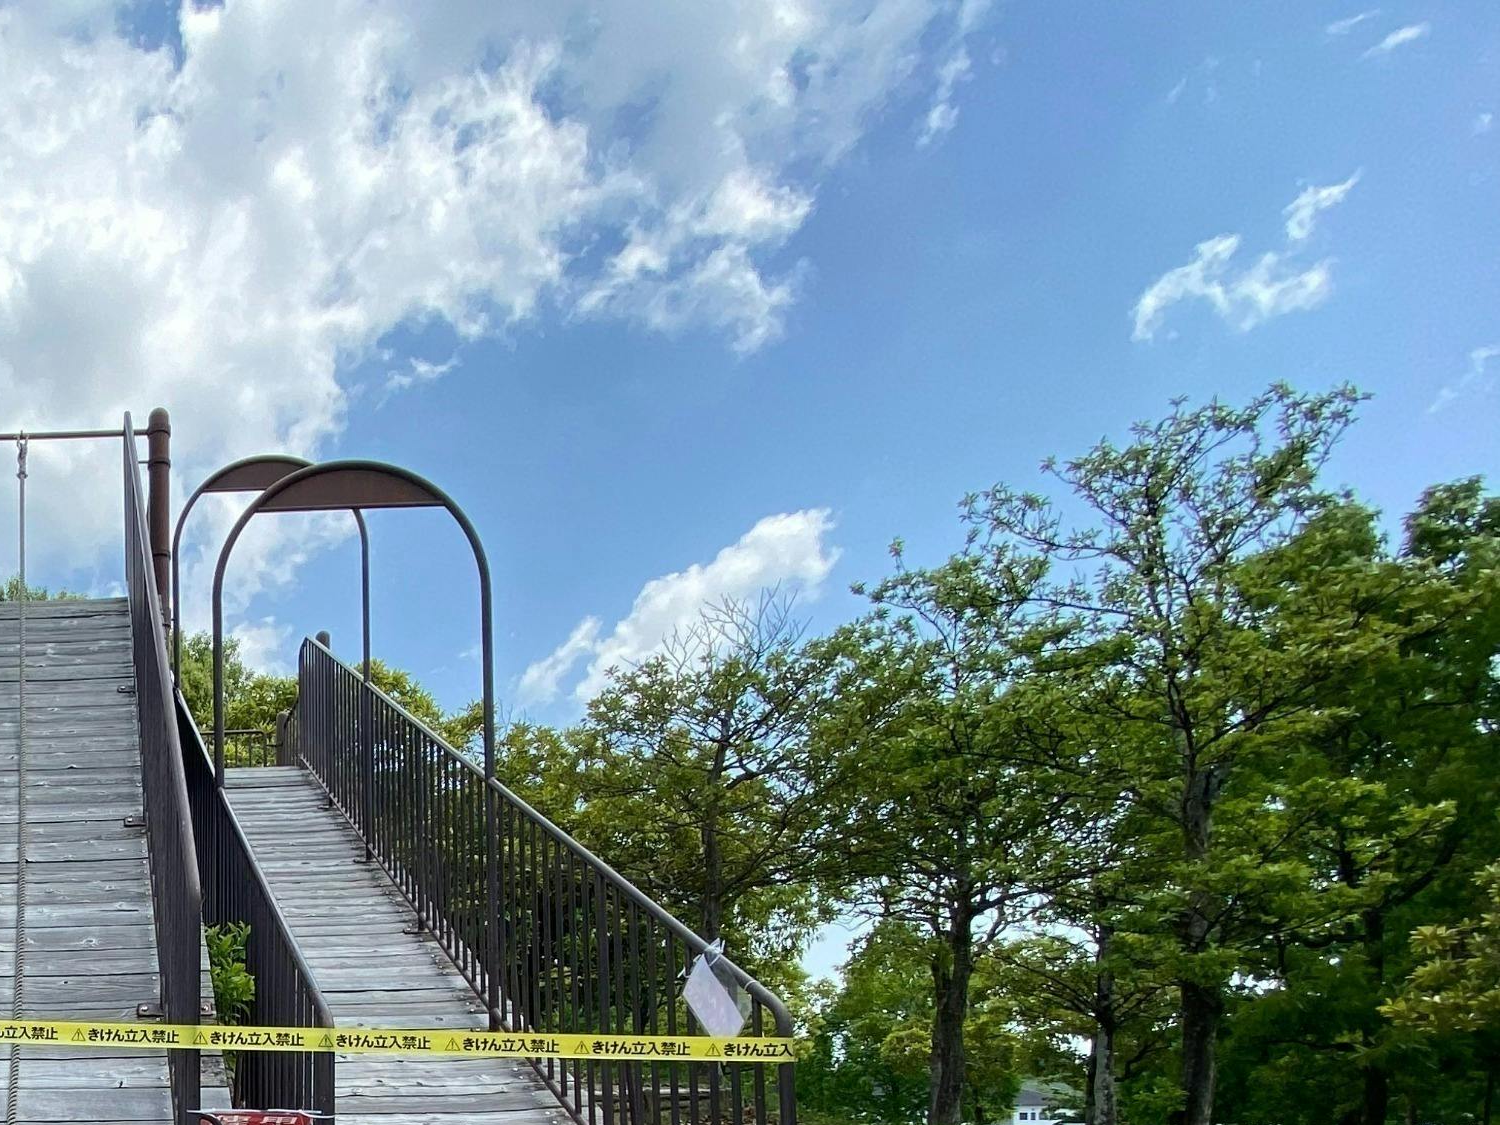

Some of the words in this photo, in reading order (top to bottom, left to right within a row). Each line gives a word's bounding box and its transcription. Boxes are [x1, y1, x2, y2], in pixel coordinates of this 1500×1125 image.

[86, 1029, 180, 1045] きけん立入禁止
[210, 1031, 304, 1048] きけん立入禁止
[335, 1035, 431, 1052] きけん立入禁止
[462, 1038, 559, 1054] きけん立入禁止
[592, 1041, 690, 1056] きけん立入禁止
